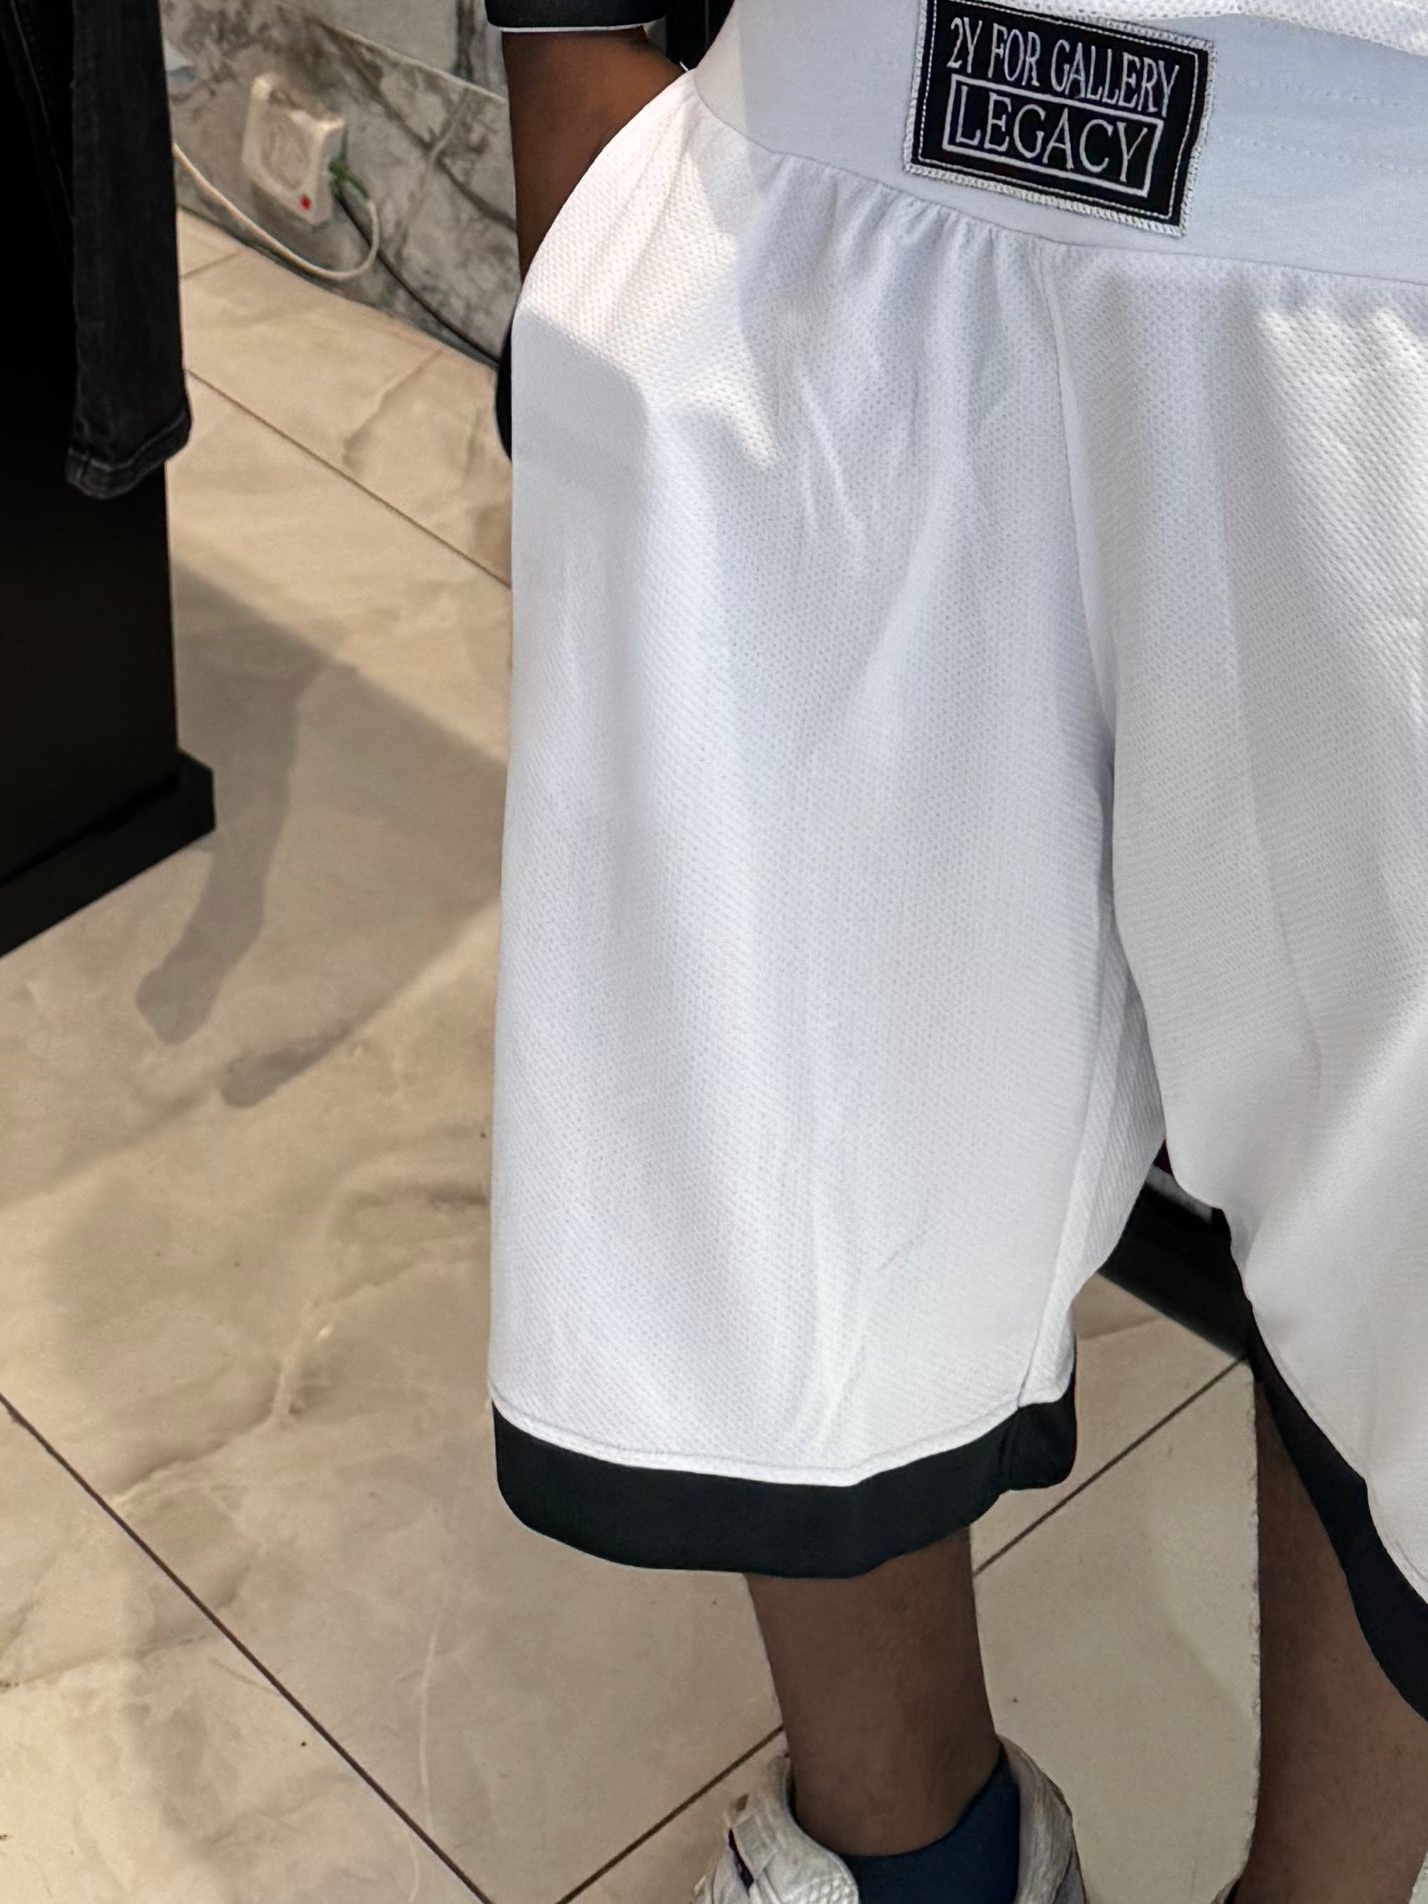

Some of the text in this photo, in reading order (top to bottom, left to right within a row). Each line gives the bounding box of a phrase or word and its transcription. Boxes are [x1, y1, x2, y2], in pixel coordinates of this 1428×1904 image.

[946, 16, 1180, 118] 2Y FOR GALLERY
[955, 85, 1149, 183] LEGACY
